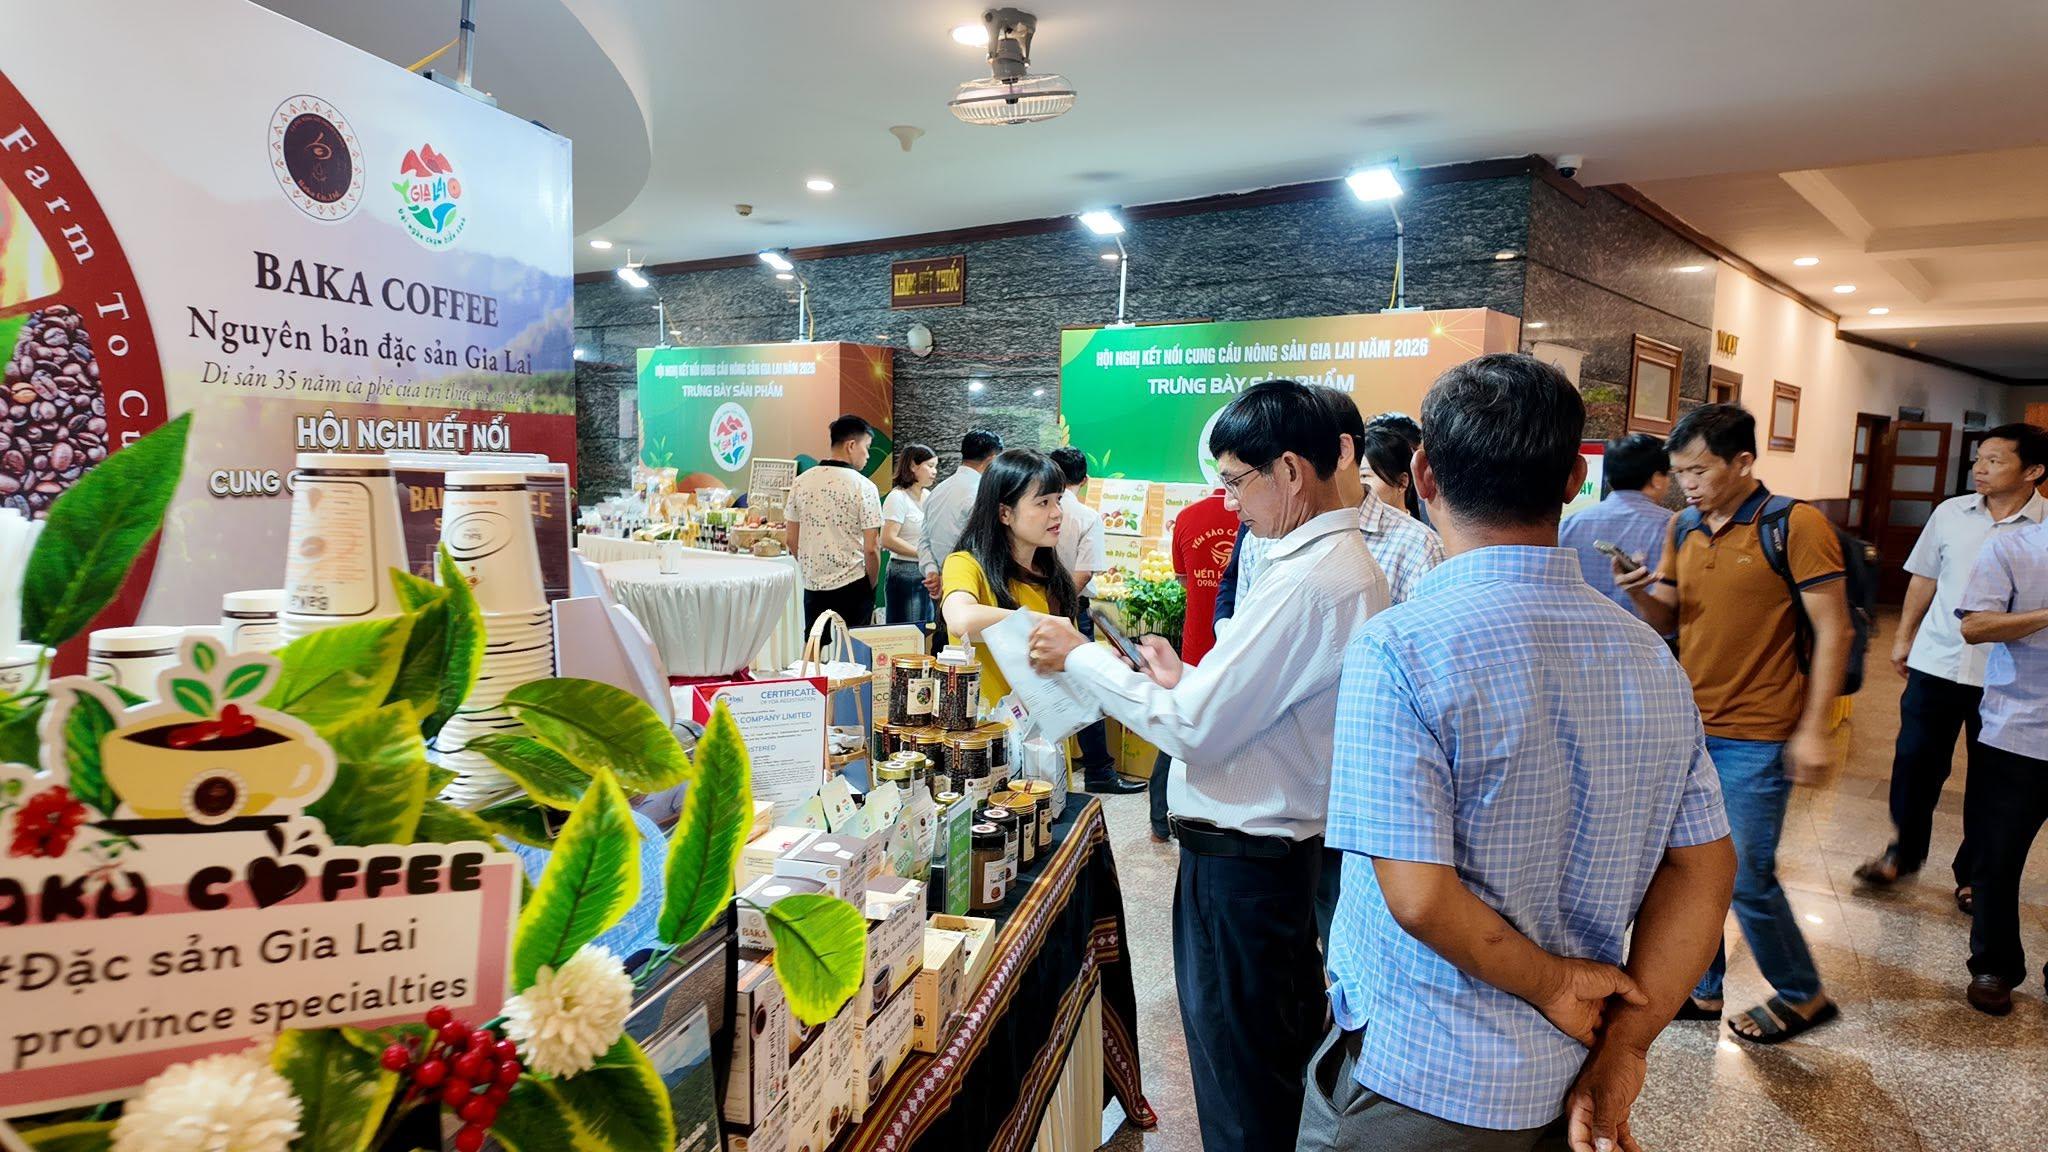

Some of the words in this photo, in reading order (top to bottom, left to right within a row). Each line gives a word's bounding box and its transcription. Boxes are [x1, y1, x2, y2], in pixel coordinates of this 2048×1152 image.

[0, 123, 95, 265] Farm
[95, 292, 130, 356] To
[254, 251, 373, 307] BAKA
[381, 278, 499, 328] COFFEE
[187, 305, 311, 357] Nguyên
[322, 324, 369, 358] bản
[377, 332, 416, 367] đặc
[424, 339, 457, 367] sản
[465, 345, 498, 372] Gia
[505, 350, 533, 375] Lai
[1096, 348, 1113, 369] HỘI
[1115, 350, 1140, 368] NGHỊ
[1142, 345, 1163, 365] KẾT
[1164, 343, 1183, 365] NỐI
[1185, 347, 1215, 364] CUNG
[1218, 341, 1241, 363] CẦU
[1244, 342, 1278, 363] NÔNG
[1281, 339, 1306, 362] SẢN
[1310, 342, 1331, 361] GIA
[1335, 341, 1356, 360] LAI
[1358, 337, 1390, 359] NĂM
[1394, 338, 1429, 358] 2026
[200, 361, 230, 384] Di
[234, 365, 267, 387] sản
[273, 370, 297, 390] 35
[302, 375, 340, 393] năm
[346, 376, 362, 393] cà
[366, 376, 393, 401] phê
[682, 384, 712, 397] TRƯNG
[713, 382, 731, 397] BÀY
[1147, 376, 1206, 395] TRƯNG
[1210, 374, 1247, 394] BÀY
[296, 409, 350, 454] HỘI
[427, 411, 468, 449] KẾT
[473, 413, 510, 450] NỐI
[210, 469, 281, 494] CUNG
[760, 688, 816, 699] CERTIFICATE
[740, 714, 780, 724] COMPANY
[782, 712, 812, 721] LIMITED
[149, 933, 243, 979] sản
[259, 927, 340, 967] Gia
[354, 917, 420, 957] Lai
[13, 1004, 237, 1070] province
[249, 975, 469, 1033] specialties
